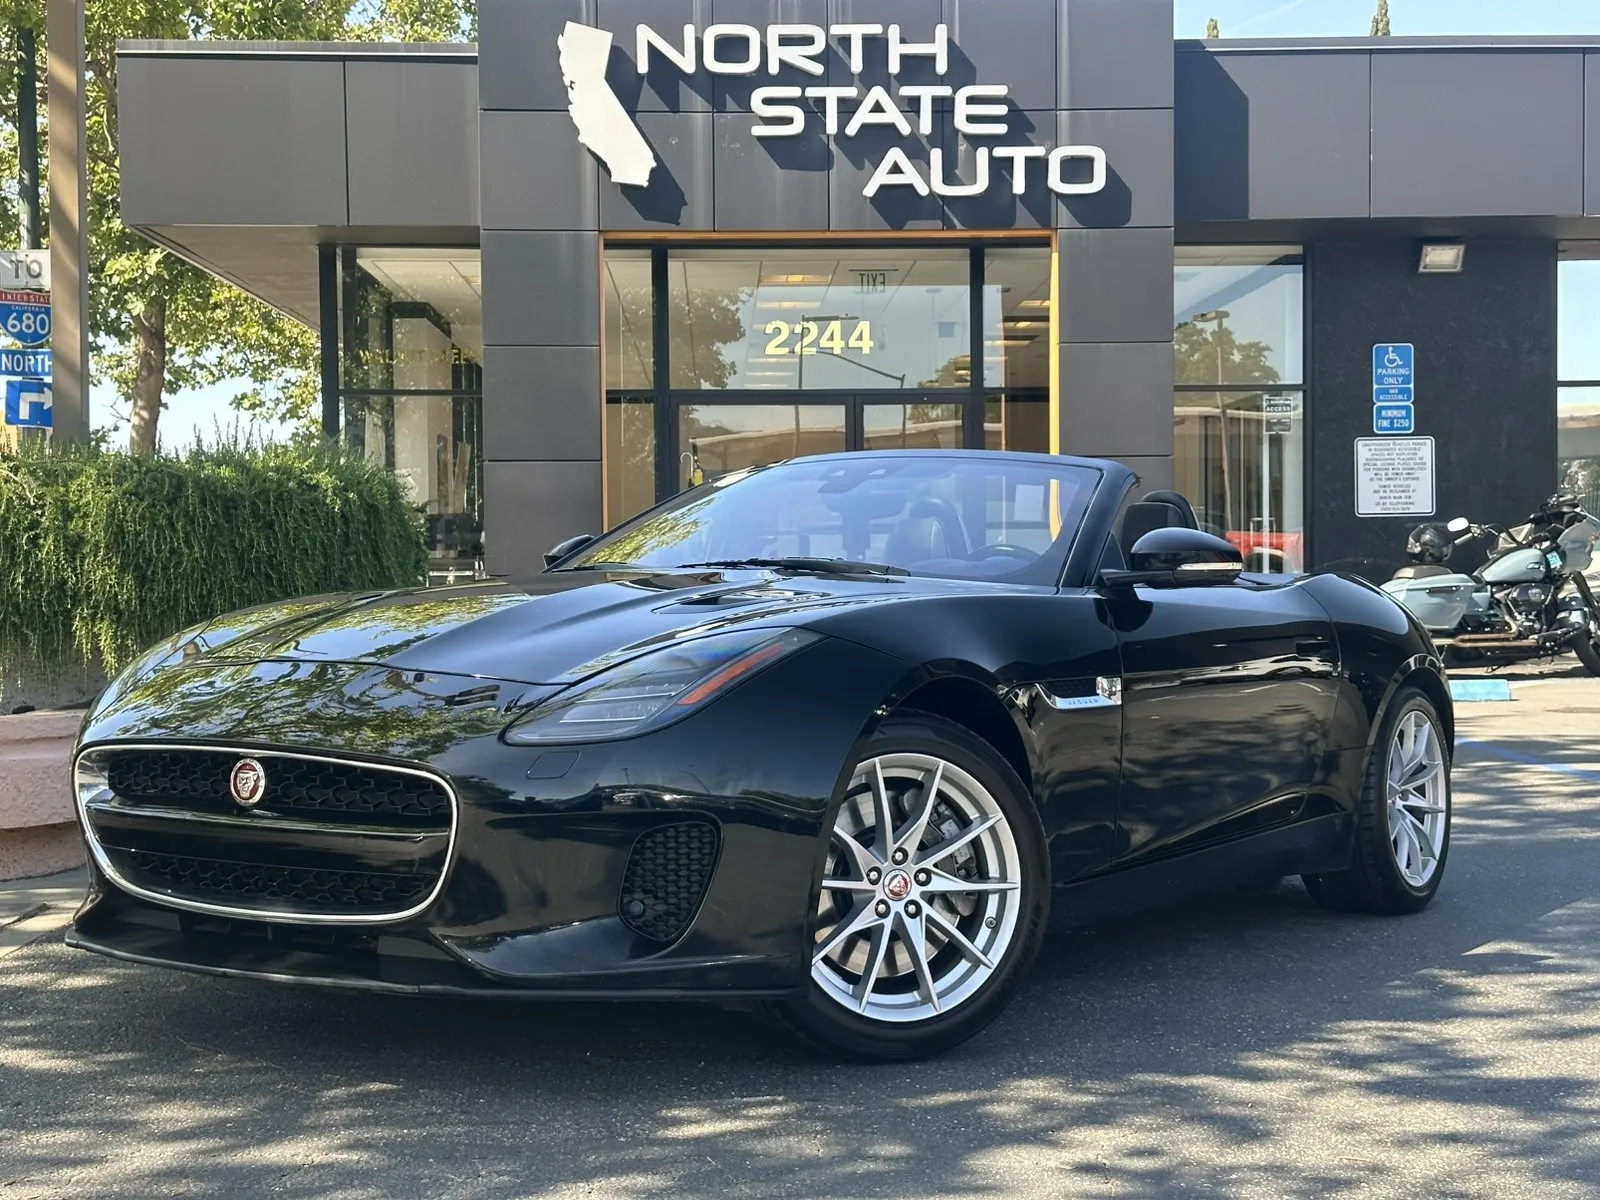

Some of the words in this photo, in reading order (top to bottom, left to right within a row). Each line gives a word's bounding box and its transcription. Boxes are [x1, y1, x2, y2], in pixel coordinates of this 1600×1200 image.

[635, 23, 947, 76] NORTH
[750, 85, 1009, 137] STATE
[862, 145, 1108, 198] AUTO
[10, 259, 43, 279] TO
[2, 292, 51, 304] INTERSTAT
[11, 304, 45, 312] CALIFORNIA
[7, 312, 49, 335] 680
[764, 320, 874, 355] 2244
[1378, 419, 1391, 428] FINE
[1393, 419, 1410, 428] $250
[1381, 410, 1406, 418] MINIMUM
[1068, 698, 1099, 706] JAGUAR
